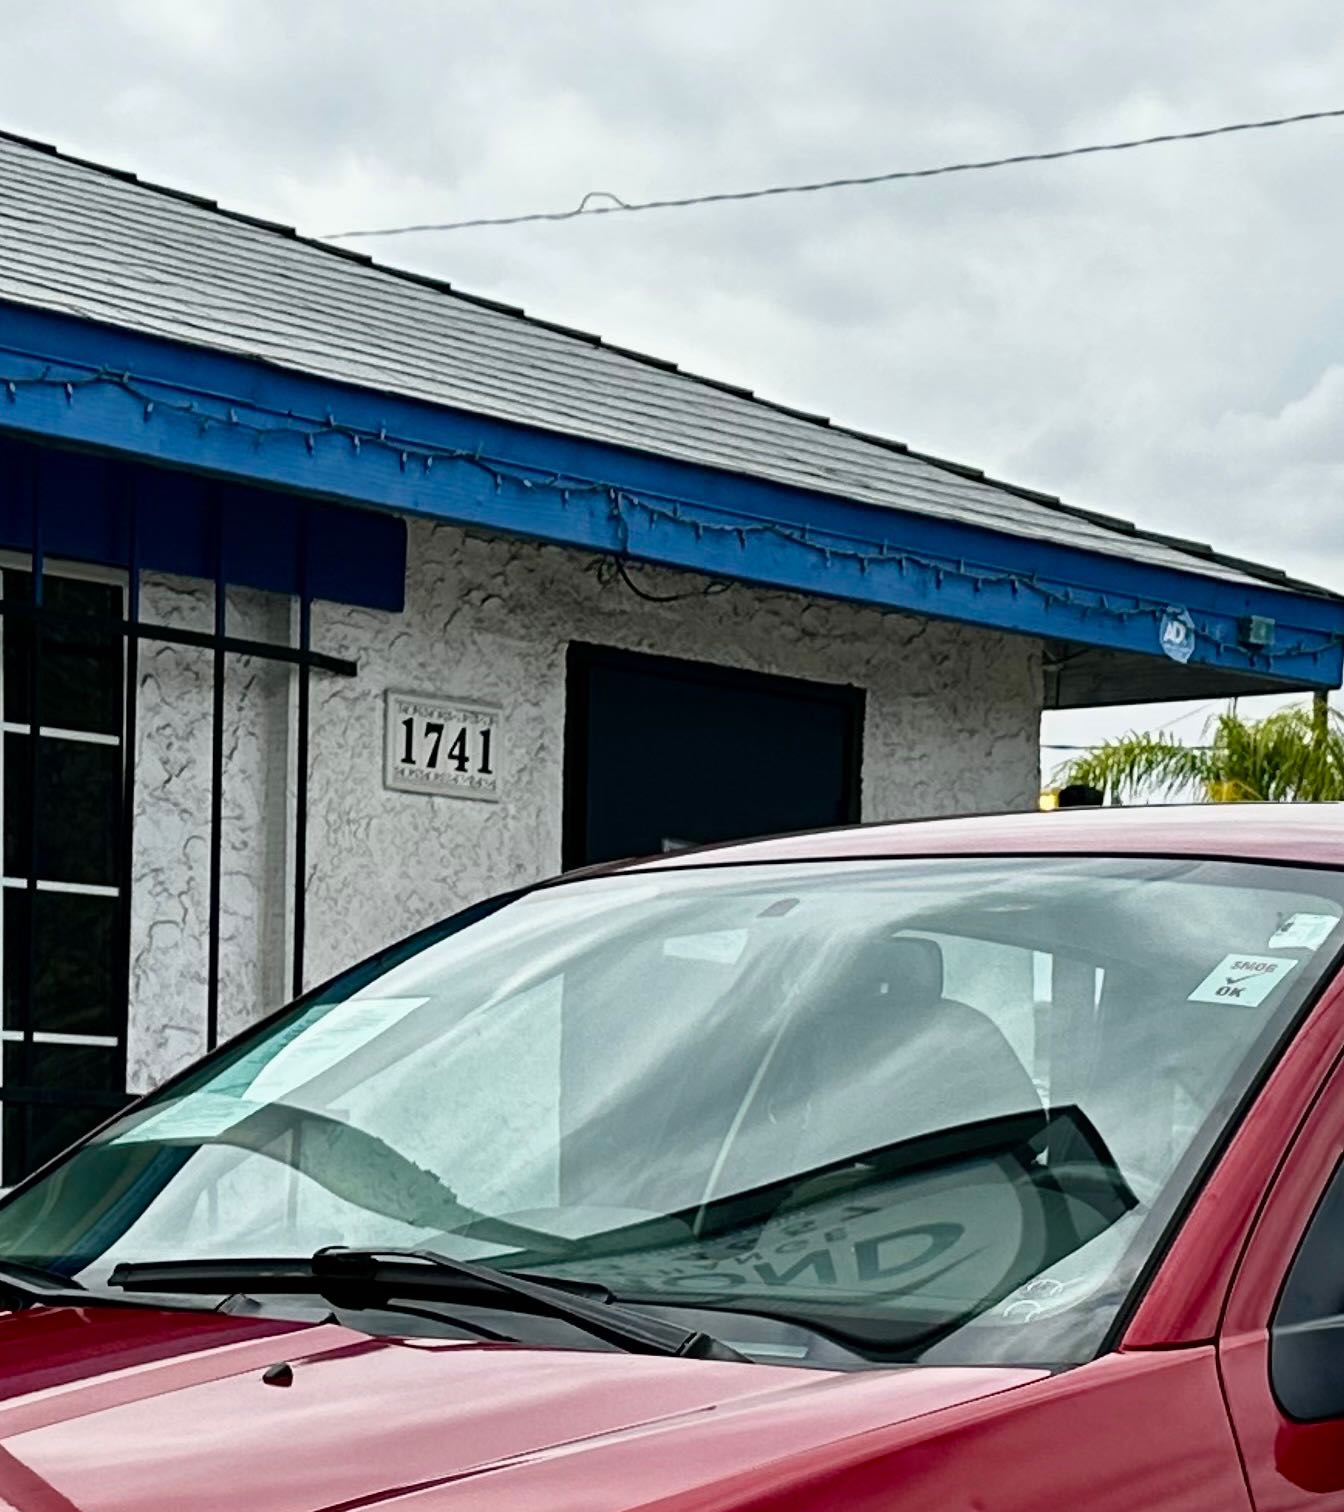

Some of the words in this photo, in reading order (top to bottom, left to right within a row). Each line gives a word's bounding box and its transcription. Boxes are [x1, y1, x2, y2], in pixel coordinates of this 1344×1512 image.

[401, 717, 493, 774] 1741
[1231, 961, 1278, 973] SMOG
[1215, 986, 1247, 998] OK
